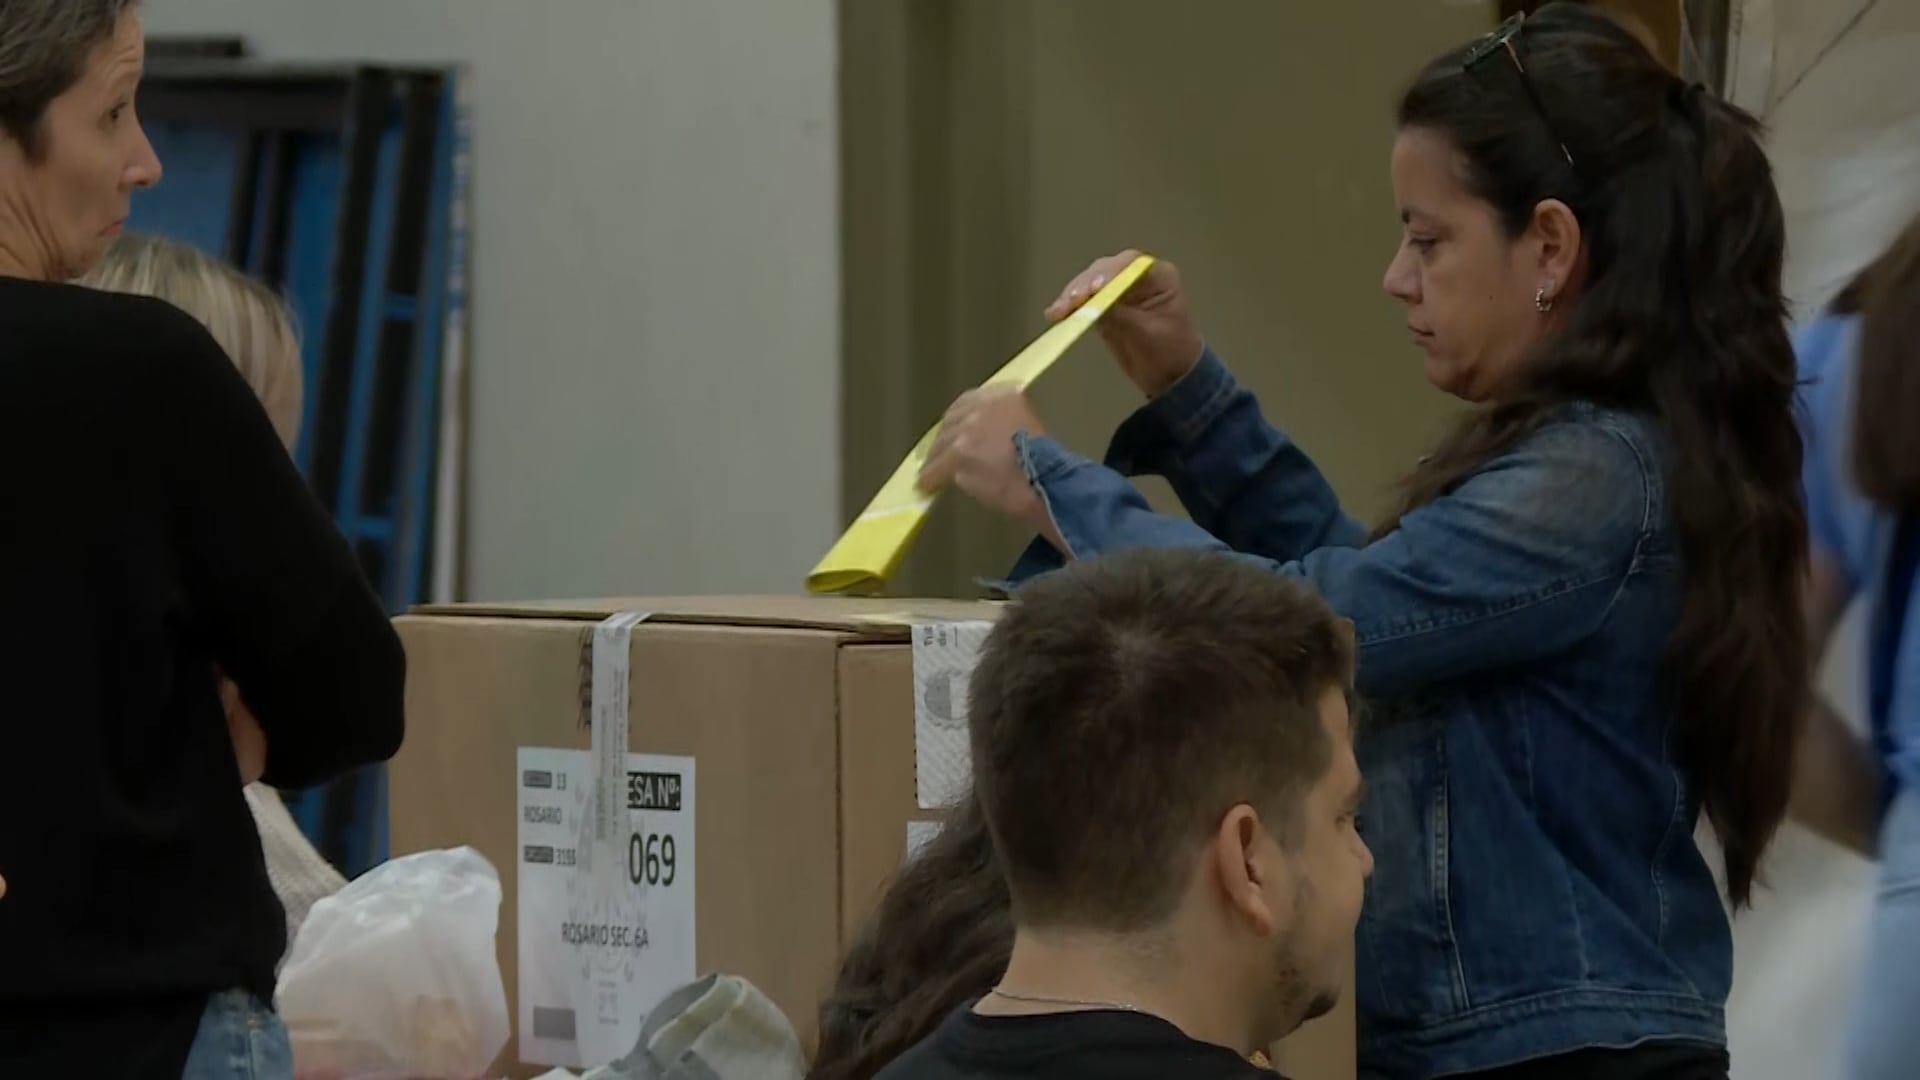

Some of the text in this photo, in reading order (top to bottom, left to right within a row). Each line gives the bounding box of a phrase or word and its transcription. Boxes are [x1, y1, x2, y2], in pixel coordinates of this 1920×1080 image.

[627, 775, 654, 806] ESA
[523, 806, 562, 824] ROSARIO
[629, 833, 675, 886] 069
[561, 922, 608, 945] ROSARIO
[634, 927, 649, 949] 6A
